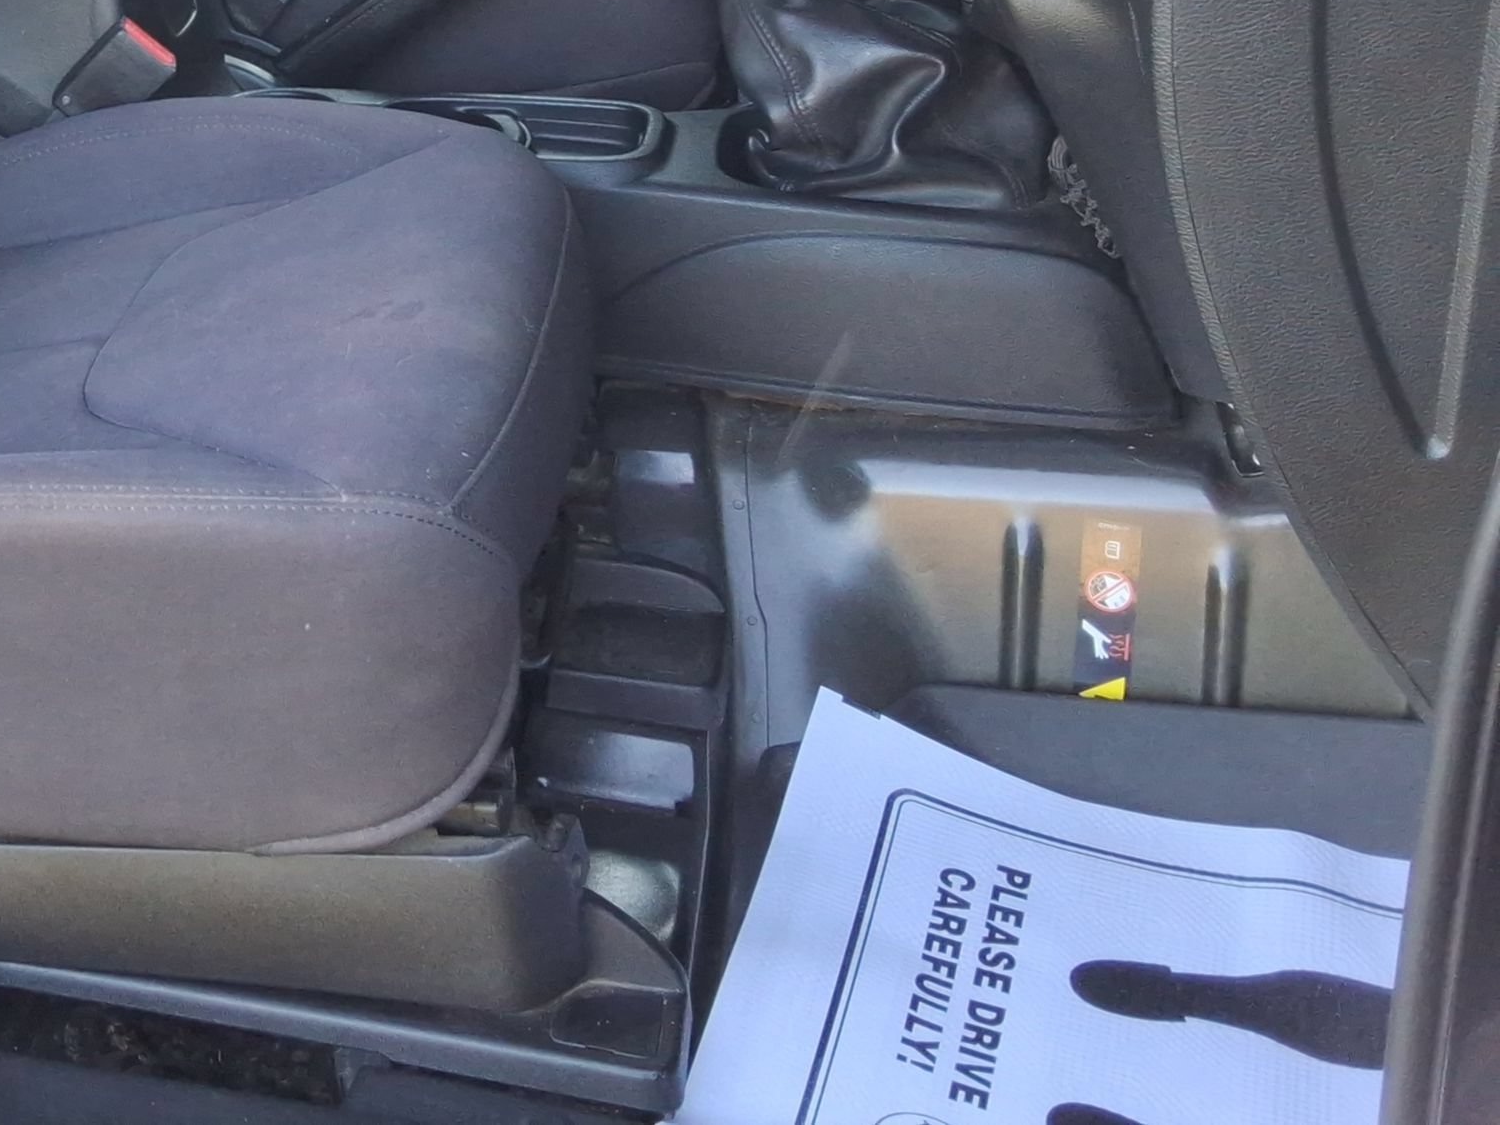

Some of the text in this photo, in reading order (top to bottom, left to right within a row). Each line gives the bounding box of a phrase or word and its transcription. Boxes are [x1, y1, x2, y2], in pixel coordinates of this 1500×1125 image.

[896, 867, 977, 1074] CAREFULLY!
[948, 864, 1032, 1111] PLEASE DRIVE
